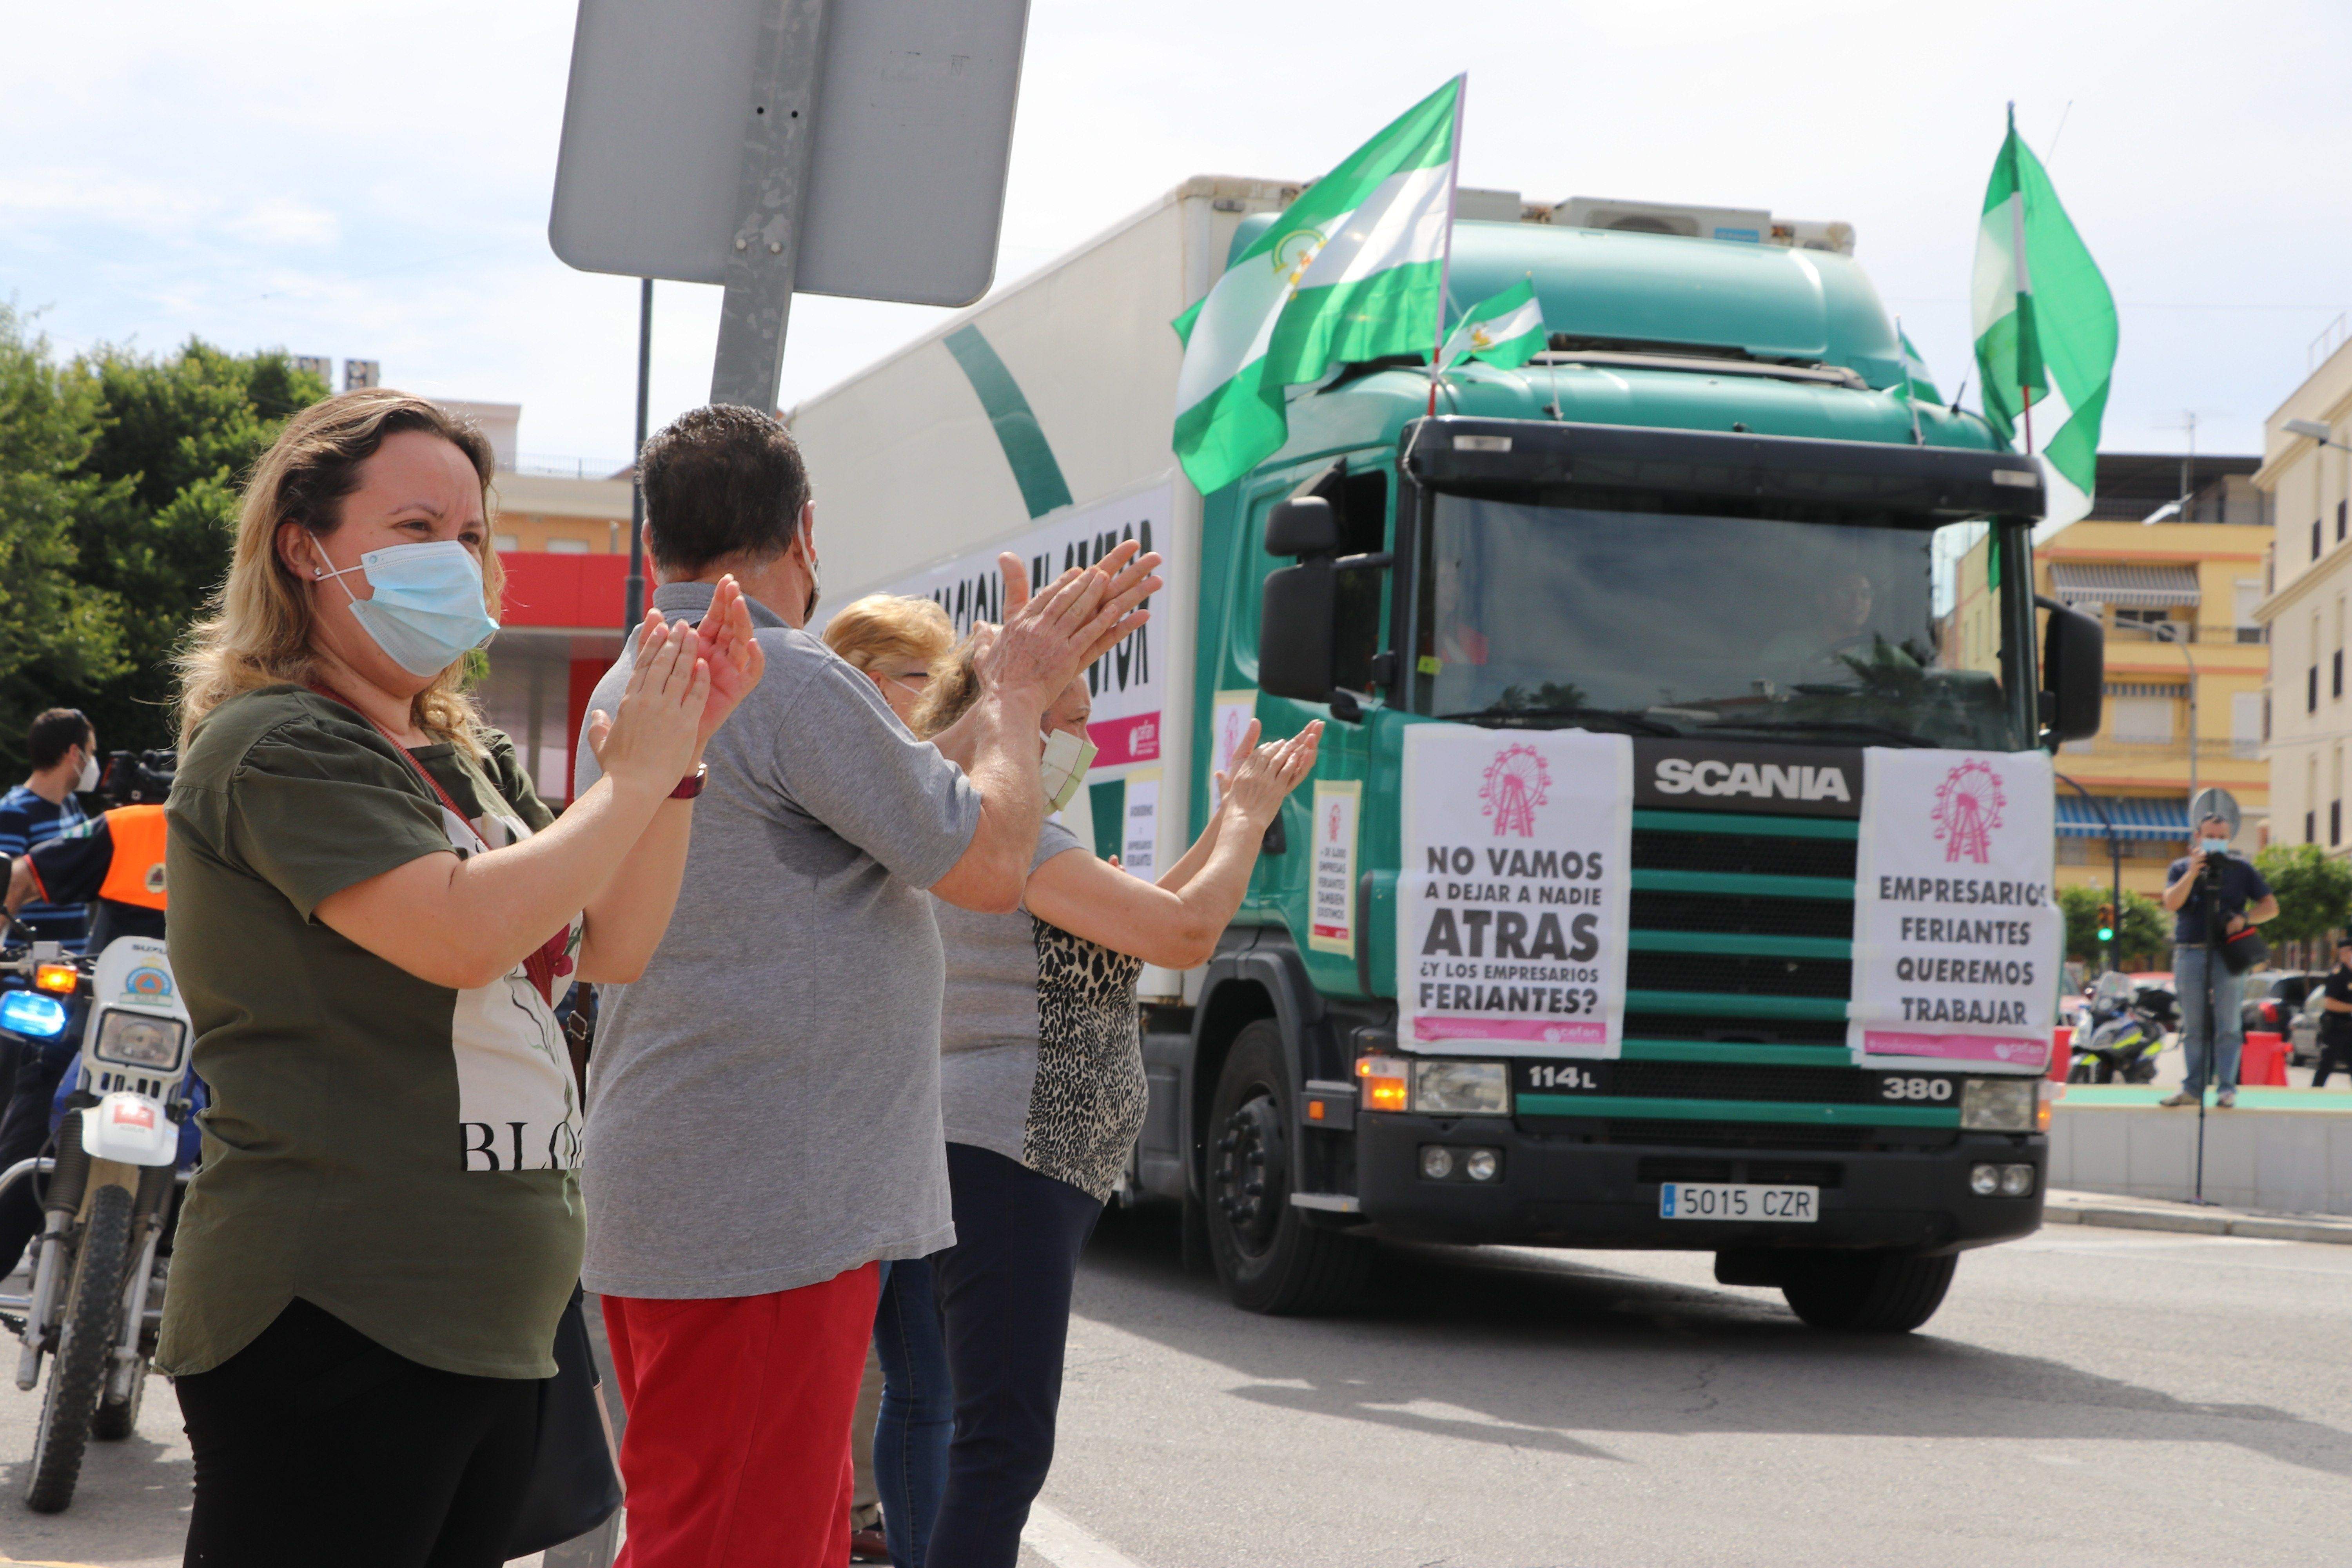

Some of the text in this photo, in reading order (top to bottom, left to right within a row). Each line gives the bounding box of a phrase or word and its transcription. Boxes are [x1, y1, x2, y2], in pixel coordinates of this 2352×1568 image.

[1655, 758, 1851, 802] SCANIA
[1427, 846, 1602, 881] NO VAMOS
[1425, 882, 1601, 906] A DEJAR A NADIE
[1421, 907, 1599, 963] ATRAS
[1902, 917, 2030, 946] FERIANTES
[1421, 963, 1598, 983] ¿Y LOS EMPRESARIOS
[1896, 956, 2033, 986] QUEREMOS
[1419, 983, 1598, 1015] FERIANTES?
[1902, 997, 2026, 1025] TRABAJAR
[1882, 1077, 1952, 1100] 380
[459, 1122, 584, 1171] BLO
[1684, 1188, 1810, 1216] 5015 CZR
